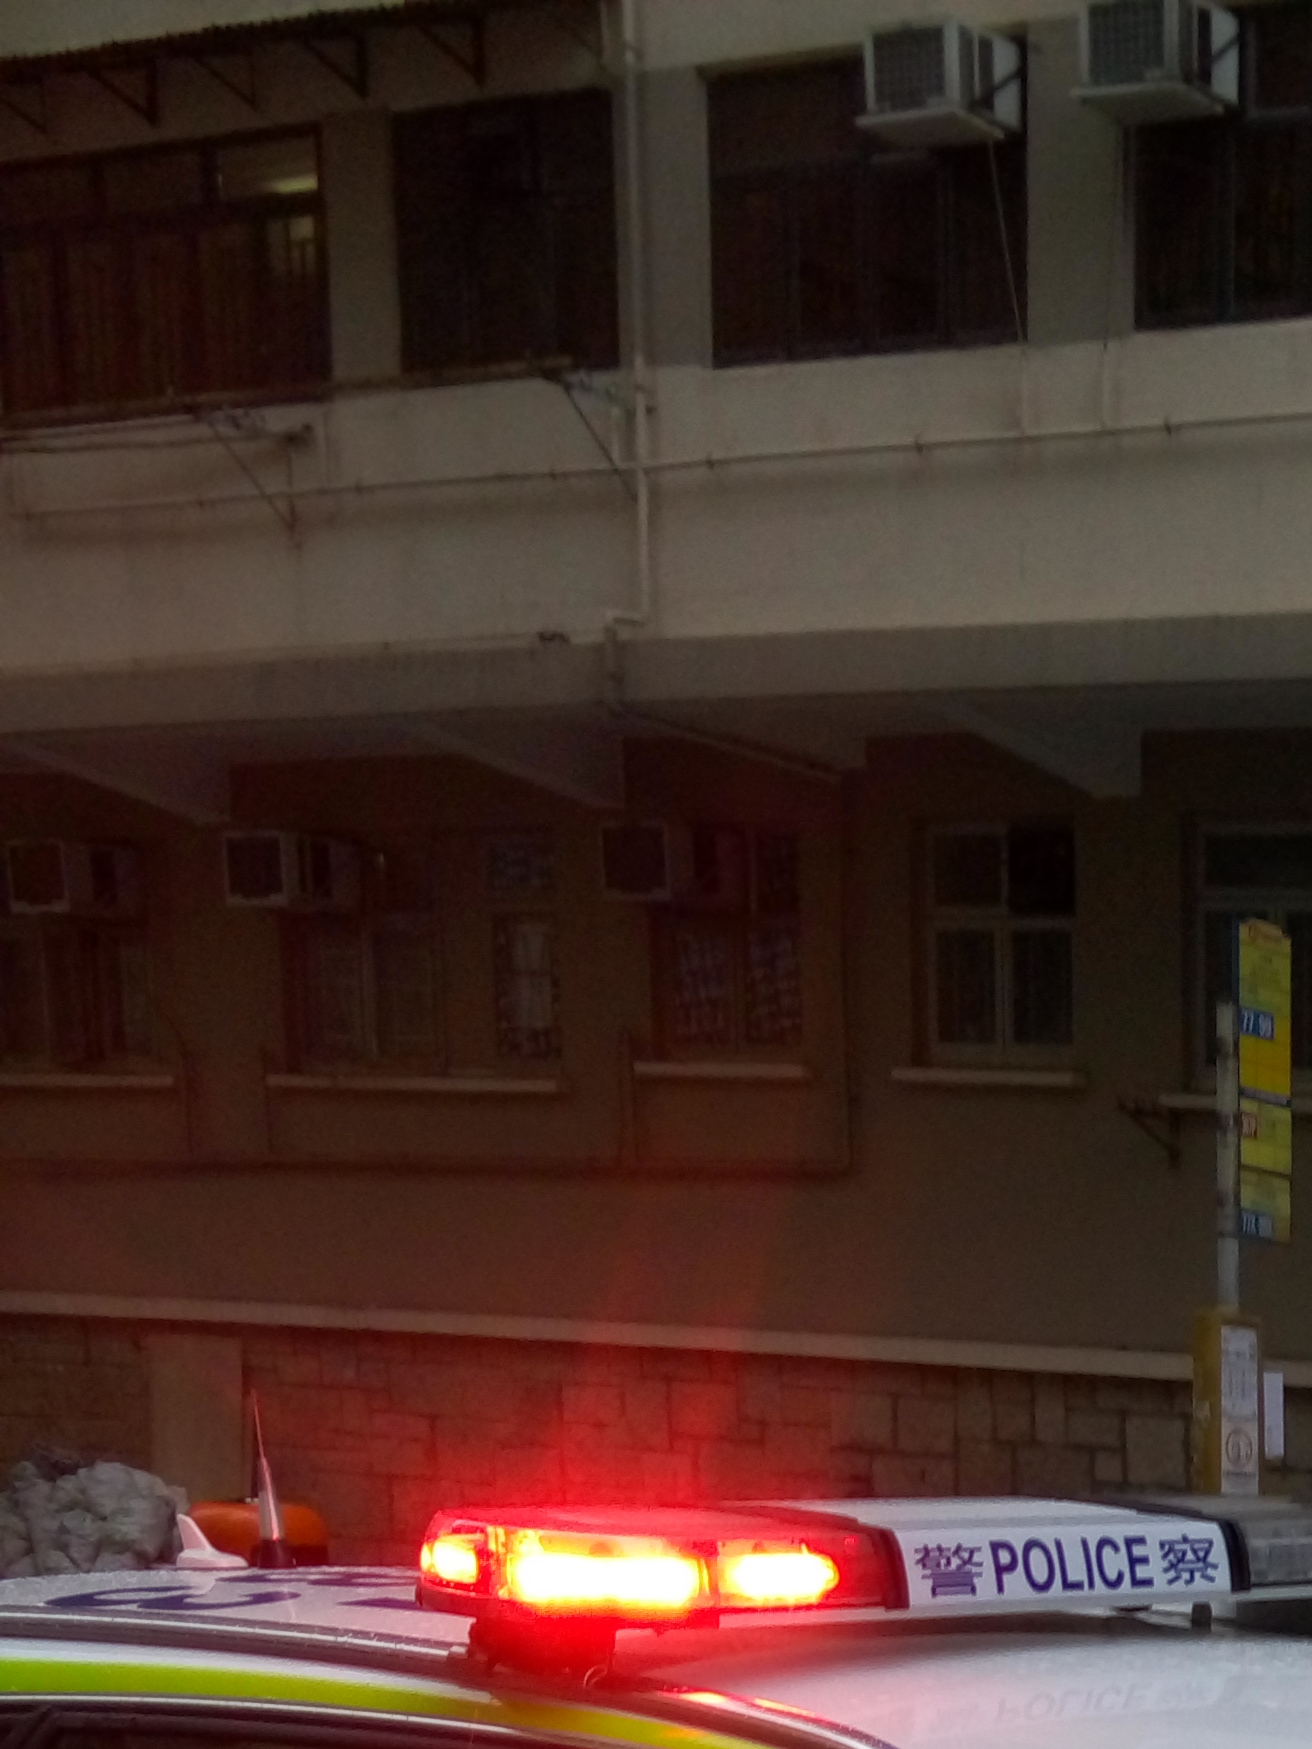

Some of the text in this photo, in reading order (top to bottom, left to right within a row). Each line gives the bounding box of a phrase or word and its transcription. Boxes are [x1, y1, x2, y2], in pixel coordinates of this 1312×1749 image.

[914, 1534, 1220, 1598] 警 POLICE 察
